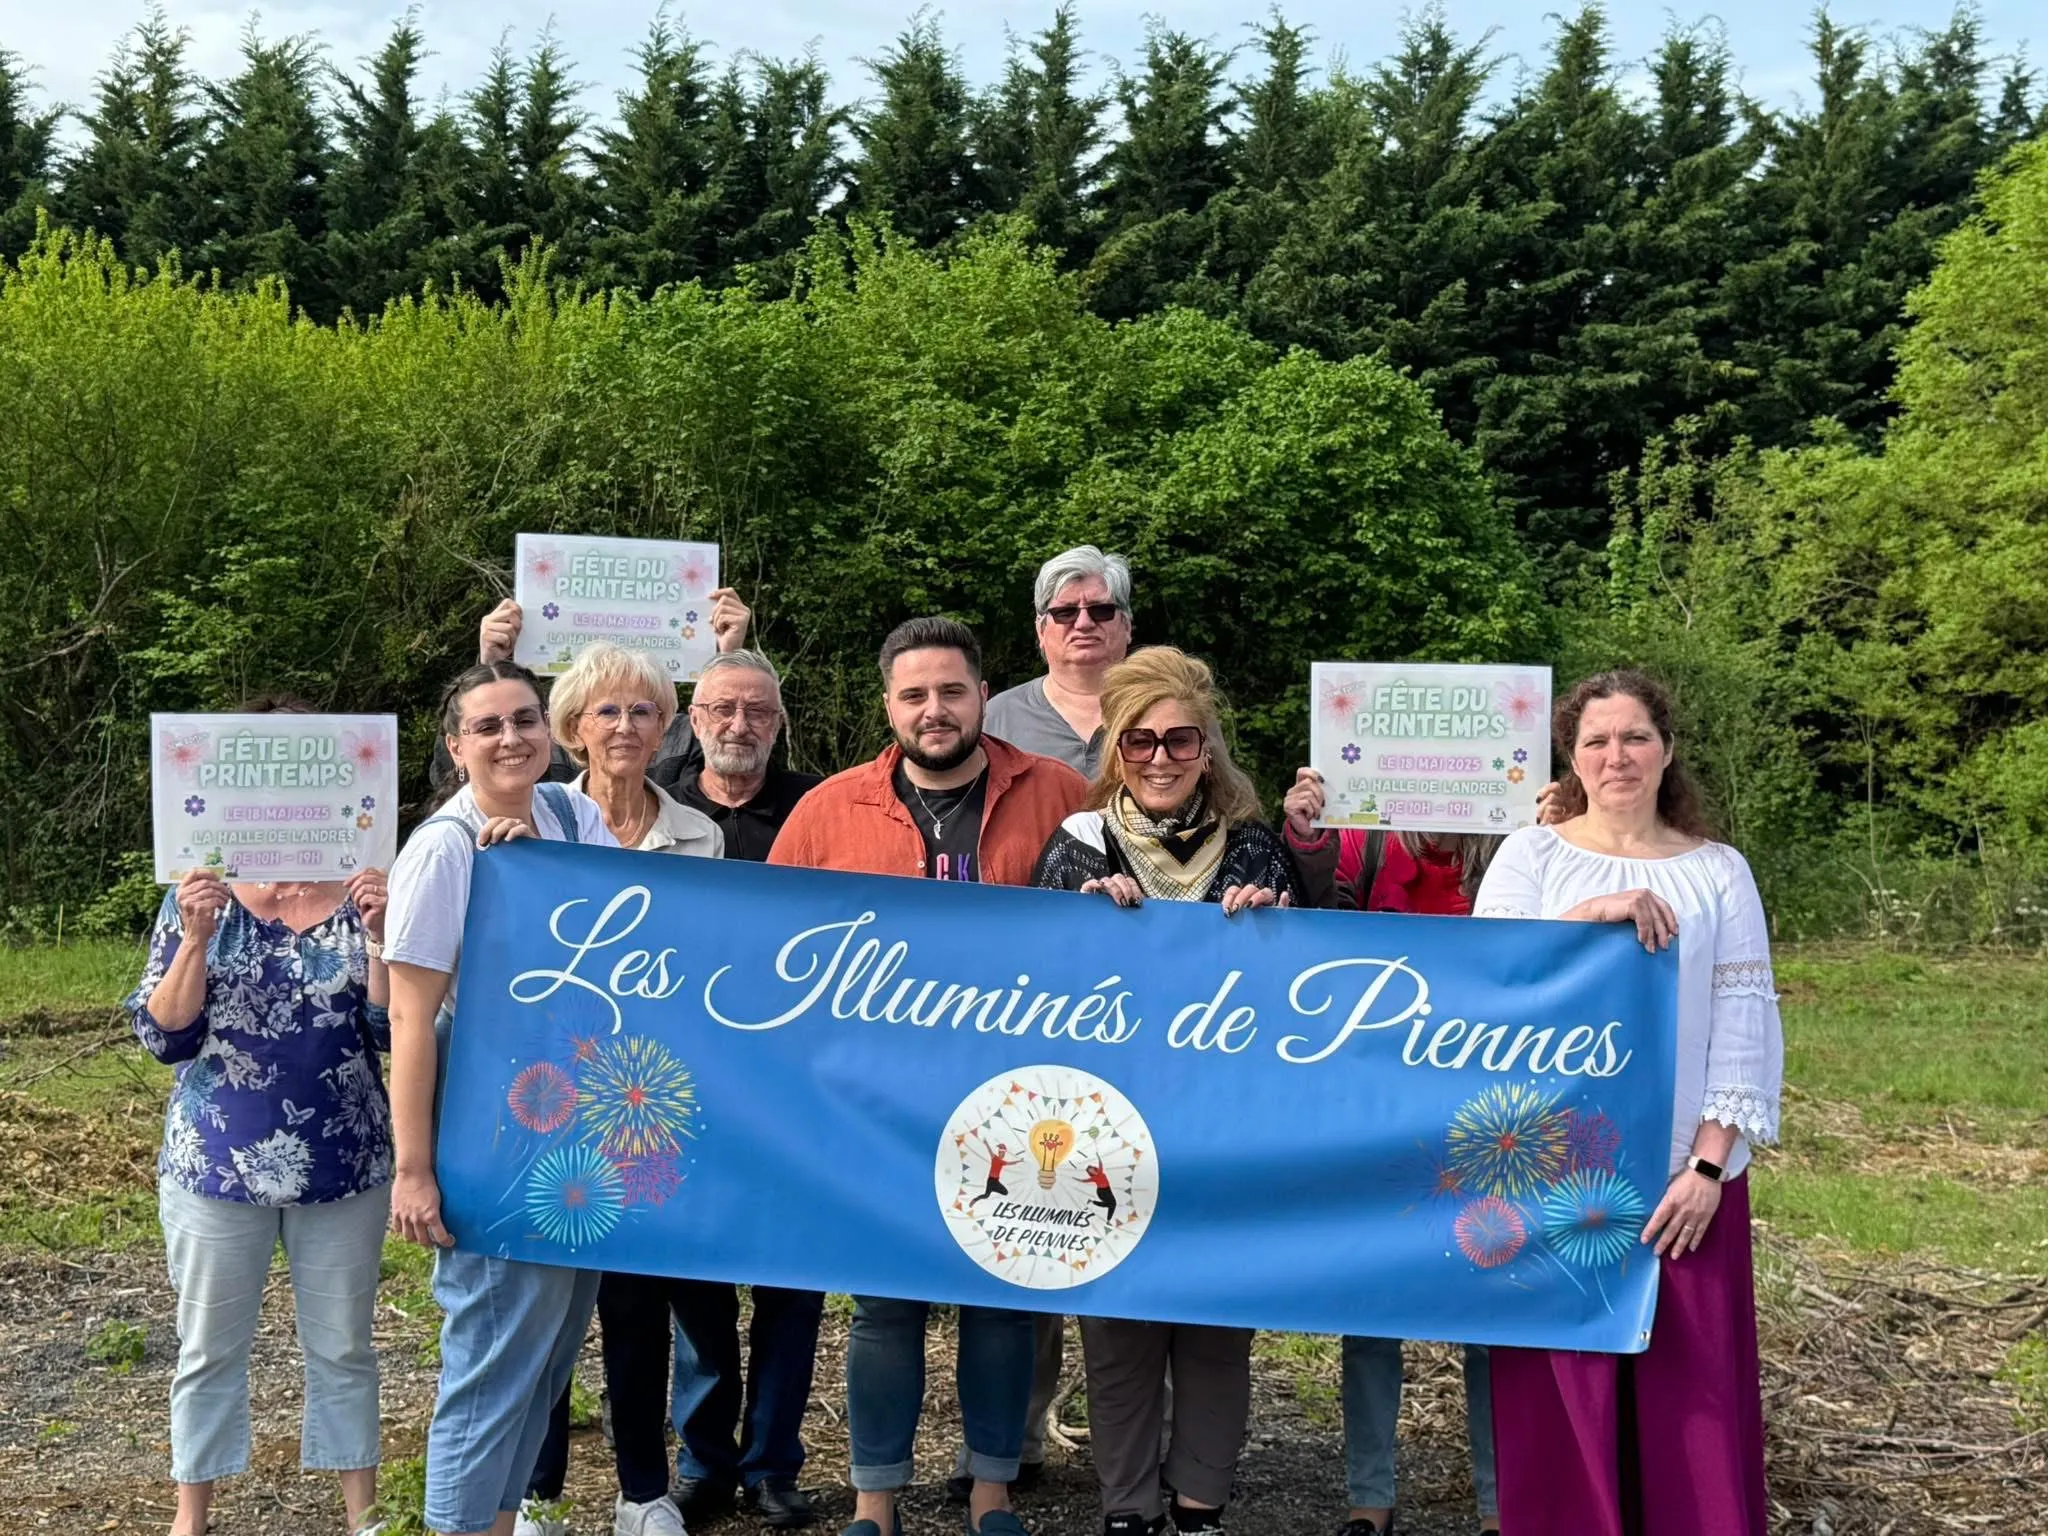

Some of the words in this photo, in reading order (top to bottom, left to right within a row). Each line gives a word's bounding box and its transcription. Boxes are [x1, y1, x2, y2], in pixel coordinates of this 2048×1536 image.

[571, 551, 629, 578] FÊTE
[636, 558, 666, 579] DU
[555, 577, 682, 602] PRINTEMPS
[573, 612, 589, 626] LE
[607, 614, 628, 628] MAI
[630, 615, 660, 629] 2025
[549, 632, 566, 645] LA
[628, 634, 682, 650] LANDRES
[1374, 680, 1443, 712] FÊTE
[1452, 687, 1487, 712] DU
[1355, 712, 1506, 738] PRINTEMPS
[218, 730, 289, 762] FÊTE
[299, 736, 335, 761] DU
[198, 763, 355, 788] PRINTEMPS
[1378, 756, 1397, 770] LE
[1400, 756, 1413, 770] 18
[1417, 757, 1444, 771] MAI
[1447, 757, 1481, 772] 2025
[1349, 778, 1368, 793] LA
[1372, 779, 1416, 793] HALLE
[1420, 780, 1438, 794] DE
[1443, 781, 1506, 796] LANDRES
[224, 807, 243, 821] LE
[247, 807, 261, 821] 18
[265, 807, 292, 821] MAI
[296, 806, 330, 821] 2025
[1386, 800, 1405, 815] DE
[1408, 801, 1431, 816] 10H
[1448, 802, 1473, 817] 19H
[192, 830, 211, 845] LA
[217, 830, 264, 844] HALLE
[268, 829, 288, 843] DE
[291, 828, 357, 843] LANDRES
[232, 852, 253, 866] DE
[256, 851, 280, 866] 10H
[297, 851, 322, 866] 19H
[508, 884, 687, 1035] Les
[703, 909, 1144, 1045] Illuminés
[1166, 969, 1258, 1055] de
[1275, 955, 1634, 1078] Piennes
[992, 1201, 1022, 1220] LES
[1018, 1204, 1096, 1229] ILLUMINÉS
[993, 1225, 1019, 1242] DE
[1017, 1228, 1091, 1252] PIENNES
